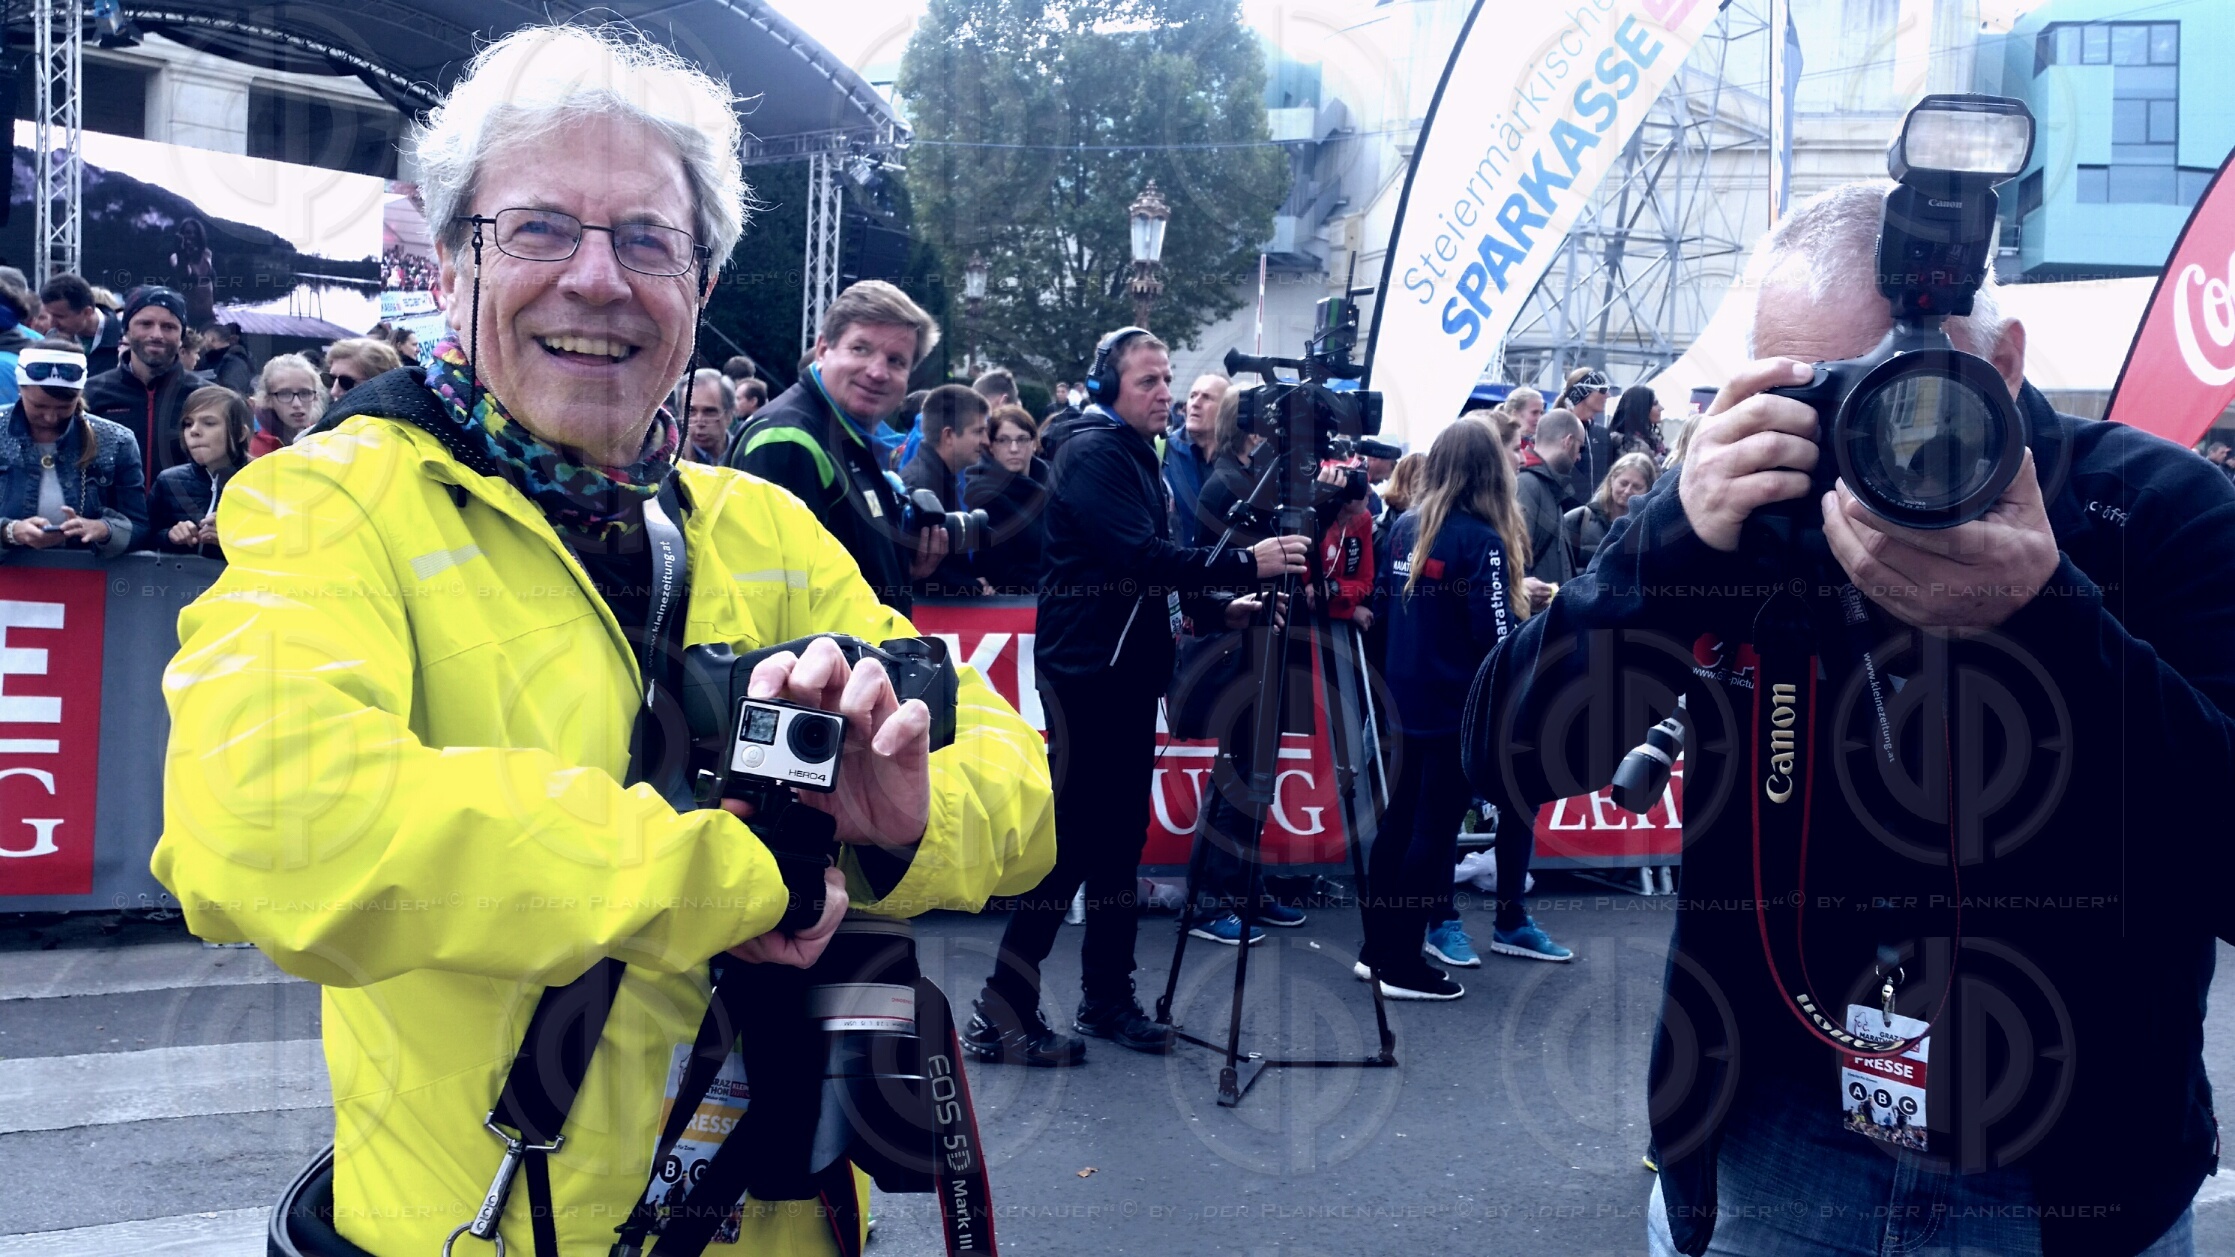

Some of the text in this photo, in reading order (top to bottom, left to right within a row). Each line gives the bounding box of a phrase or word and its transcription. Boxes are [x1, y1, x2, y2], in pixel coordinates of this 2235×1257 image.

[1441, 13, 1665, 350] SPARKASSE
[1928, 198, 1963, 209] Canon
[648, 540, 676, 668] www.kleinezeitung.at
[1844, 583, 1866, 620] KLEINE
[1863, 652, 1895, 763] www.kleinezeitung.at
[1766, 683, 1796, 804] Canon
[788, 768, 827, 783] HERO4
[1860, 1032, 1895, 1043] MARAT
[1880, 1031, 1899, 1041] GRAZ
[713, 1078, 731, 1088] RAZ
[731, 1082, 749, 1091] KLEIN
[1852, 1085, 1914, 1113] A B C
[686, 1114, 737, 1135] RESS
[928, 1054, 973, 1251] EOS 5D Mark III
[664, 1160, 676, 1178] B
